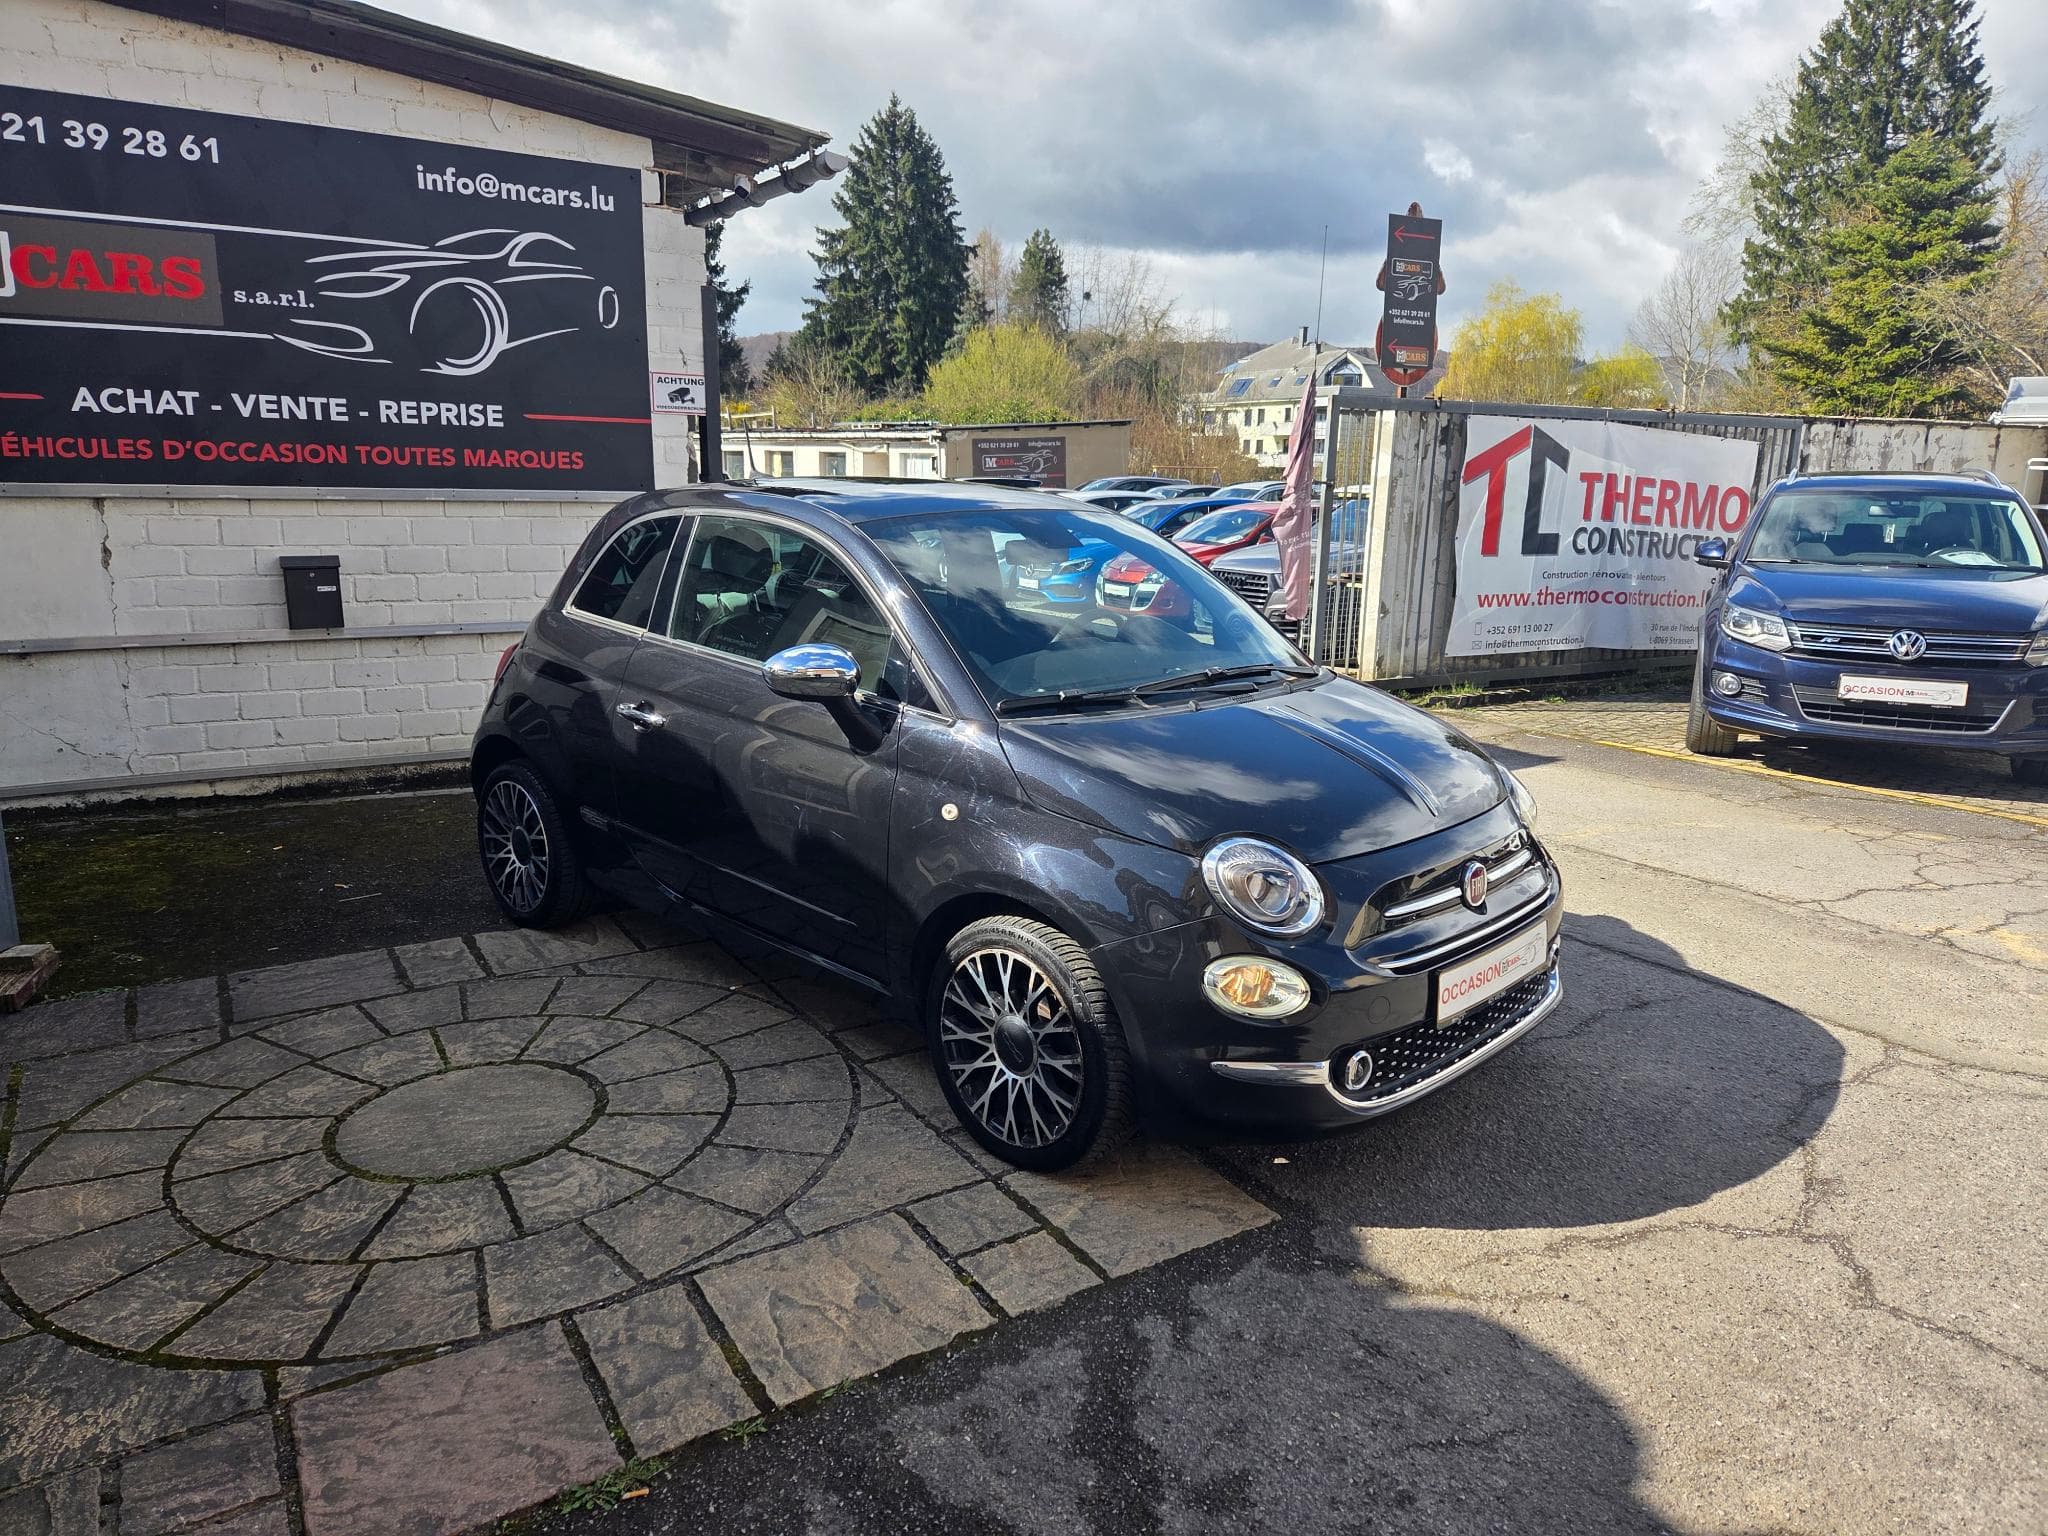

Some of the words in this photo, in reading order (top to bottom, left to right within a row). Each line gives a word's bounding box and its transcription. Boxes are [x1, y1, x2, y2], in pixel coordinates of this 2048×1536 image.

[62, 119, 109, 151] 39
[122, 127, 168, 158] 28
[179, 134, 220, 164] 61
[416, 164, 616, 212] info@mcars.lu
[0, 231, 206, 300] CARS
[233, 289, 316, 309] s.a.r.l.
[656, 376, 705, 386] ACHTUNG
[71, 386, 200, 416] ACHAT
[230, 392, 350, 422] VENTE
[379, 400, 505, 428] REPRISE
[163, 440, 349, 464] D'OCCASION
[355, 445, 457, 467] TOUTES
[464, 448, 585, 470] MARQUES
[1579, 471, 1751, 533] THERMO
[1572, 526, 1737, 561] CONSTRUC
[1542, 569, 1589, 580] Construction
[1592, 568, 1633, 580] rénova
[1478, 586, 1707, 609] www.thermoconstruction.l
[1486, 626, 1506, 635] +352
[1508, 625, 1521, 634] 691
[1523, 625, 1531, 633] 13
[1533, 624, 1543, 632] 00
[1544, 623, 1553, 632] 27
[1843, 684, 1905, 697] OCCASION
[1441, 960, 1502, 1005] OCCASION
